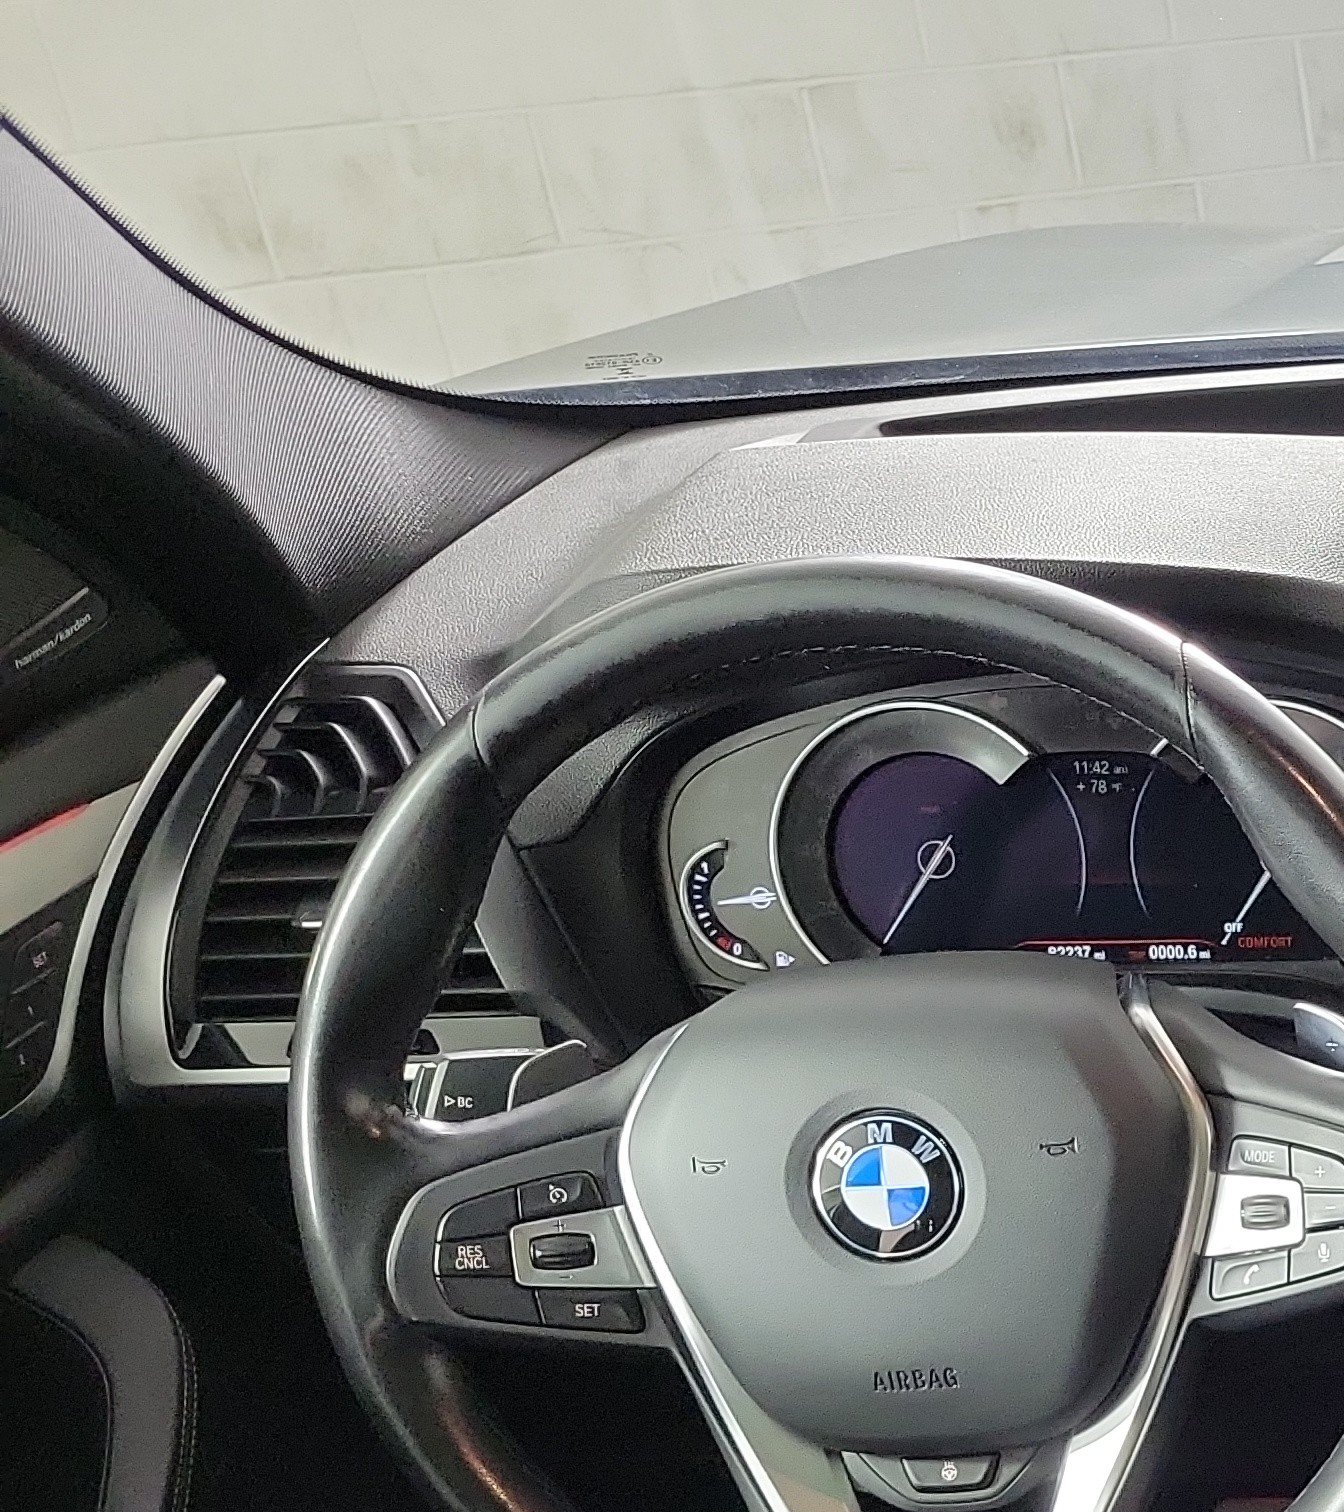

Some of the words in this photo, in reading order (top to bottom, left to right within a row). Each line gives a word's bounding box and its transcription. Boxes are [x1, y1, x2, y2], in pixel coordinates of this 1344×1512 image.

[1073, 761, 1110, 774] 11:42
[1090, 780, 1107, 793] 78
[732, 943, 742, 956] 0
[1238, 937, 1292, 949] COMFORT
[1149, 945, 1198, 960] 0000.6
[457, 1096, 473, 1108] BC
[826, 1122, 941, 1167] BMW
[1244, 1150, 1275, 1163] MODE
[457, 1245, 482, 1258] RES
[455, 1257, 490, 1270] CNCL
[575, 1303, 601, 1318] SET
[873, 1367, 960, 1393] AIRBAG
